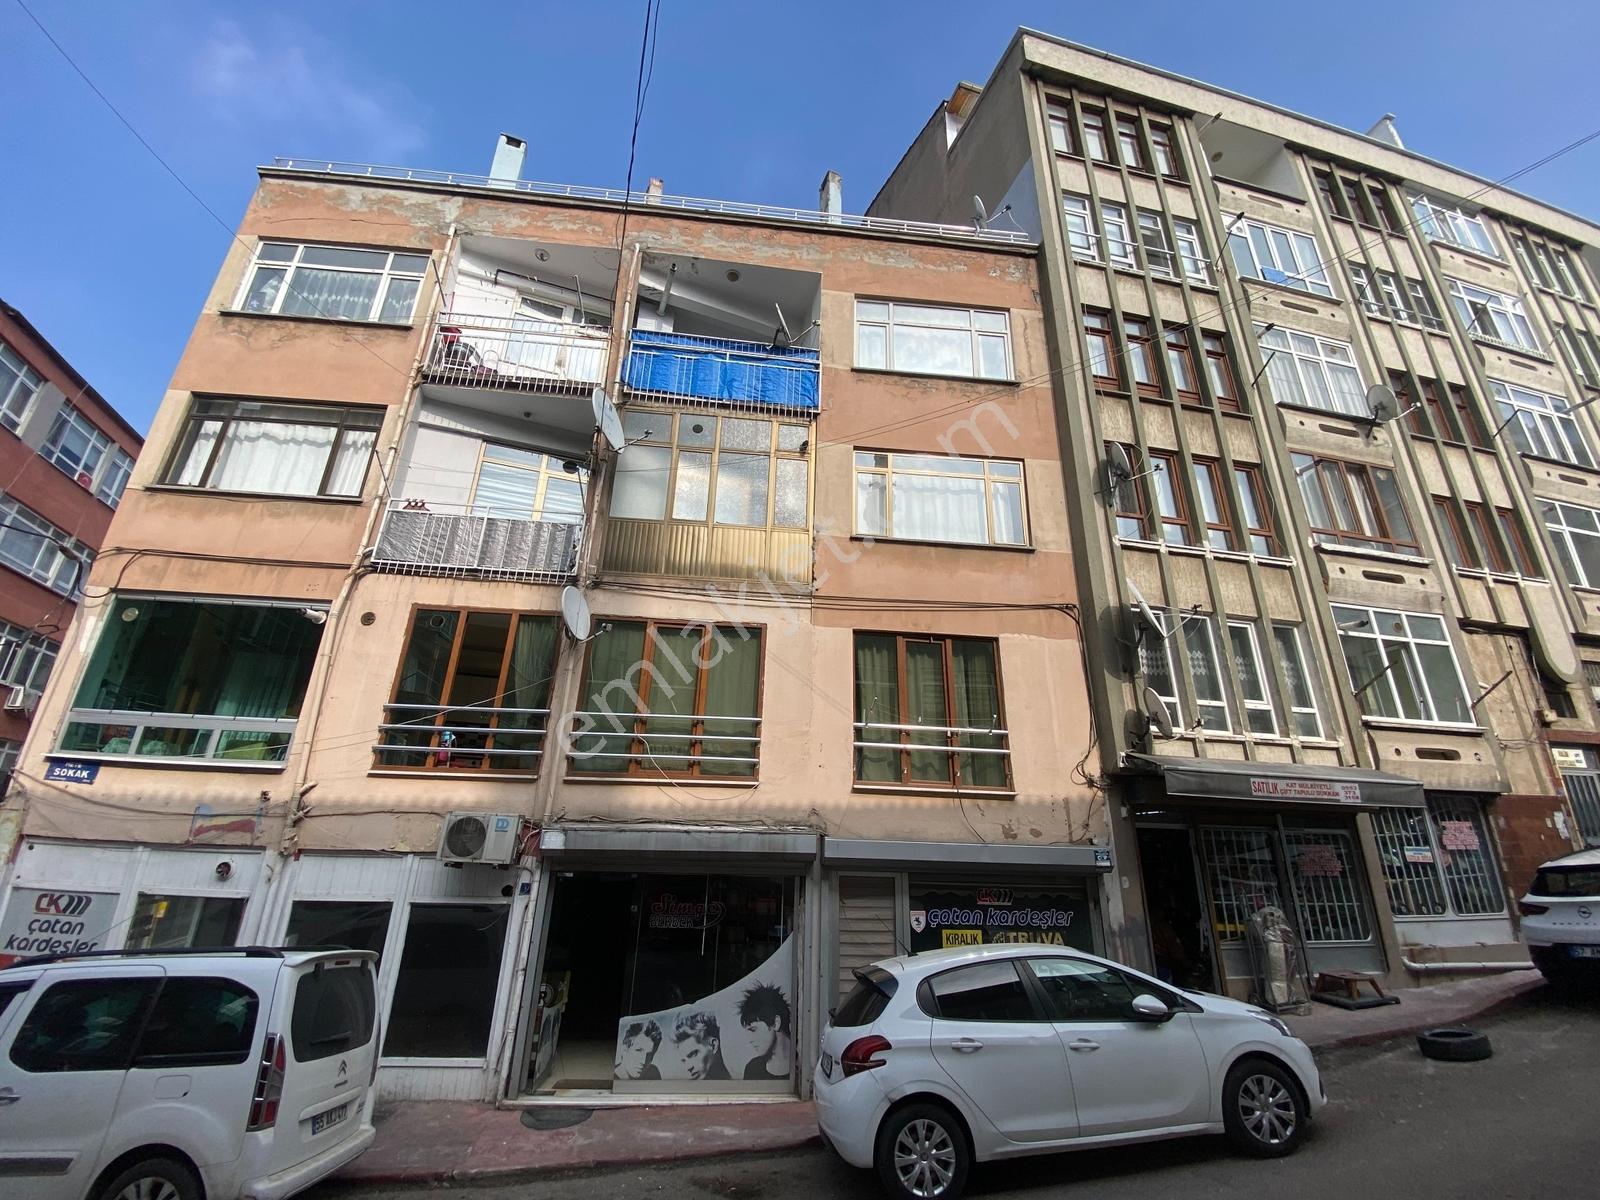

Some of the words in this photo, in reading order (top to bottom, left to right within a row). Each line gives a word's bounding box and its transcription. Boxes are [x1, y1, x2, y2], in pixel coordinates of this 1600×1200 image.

[53, 768, 91, 778] SOKAK
[1252, 781, 1279, 794] SATILIK
[928, 907, 983, 928] çatan
[986, 908, 1073, 929] kardeşler
[28, 918, 85, 935] çatan
[4, 934, 99, 953] kardeşler
[1006, 931, 1065, 946] TRUVA
